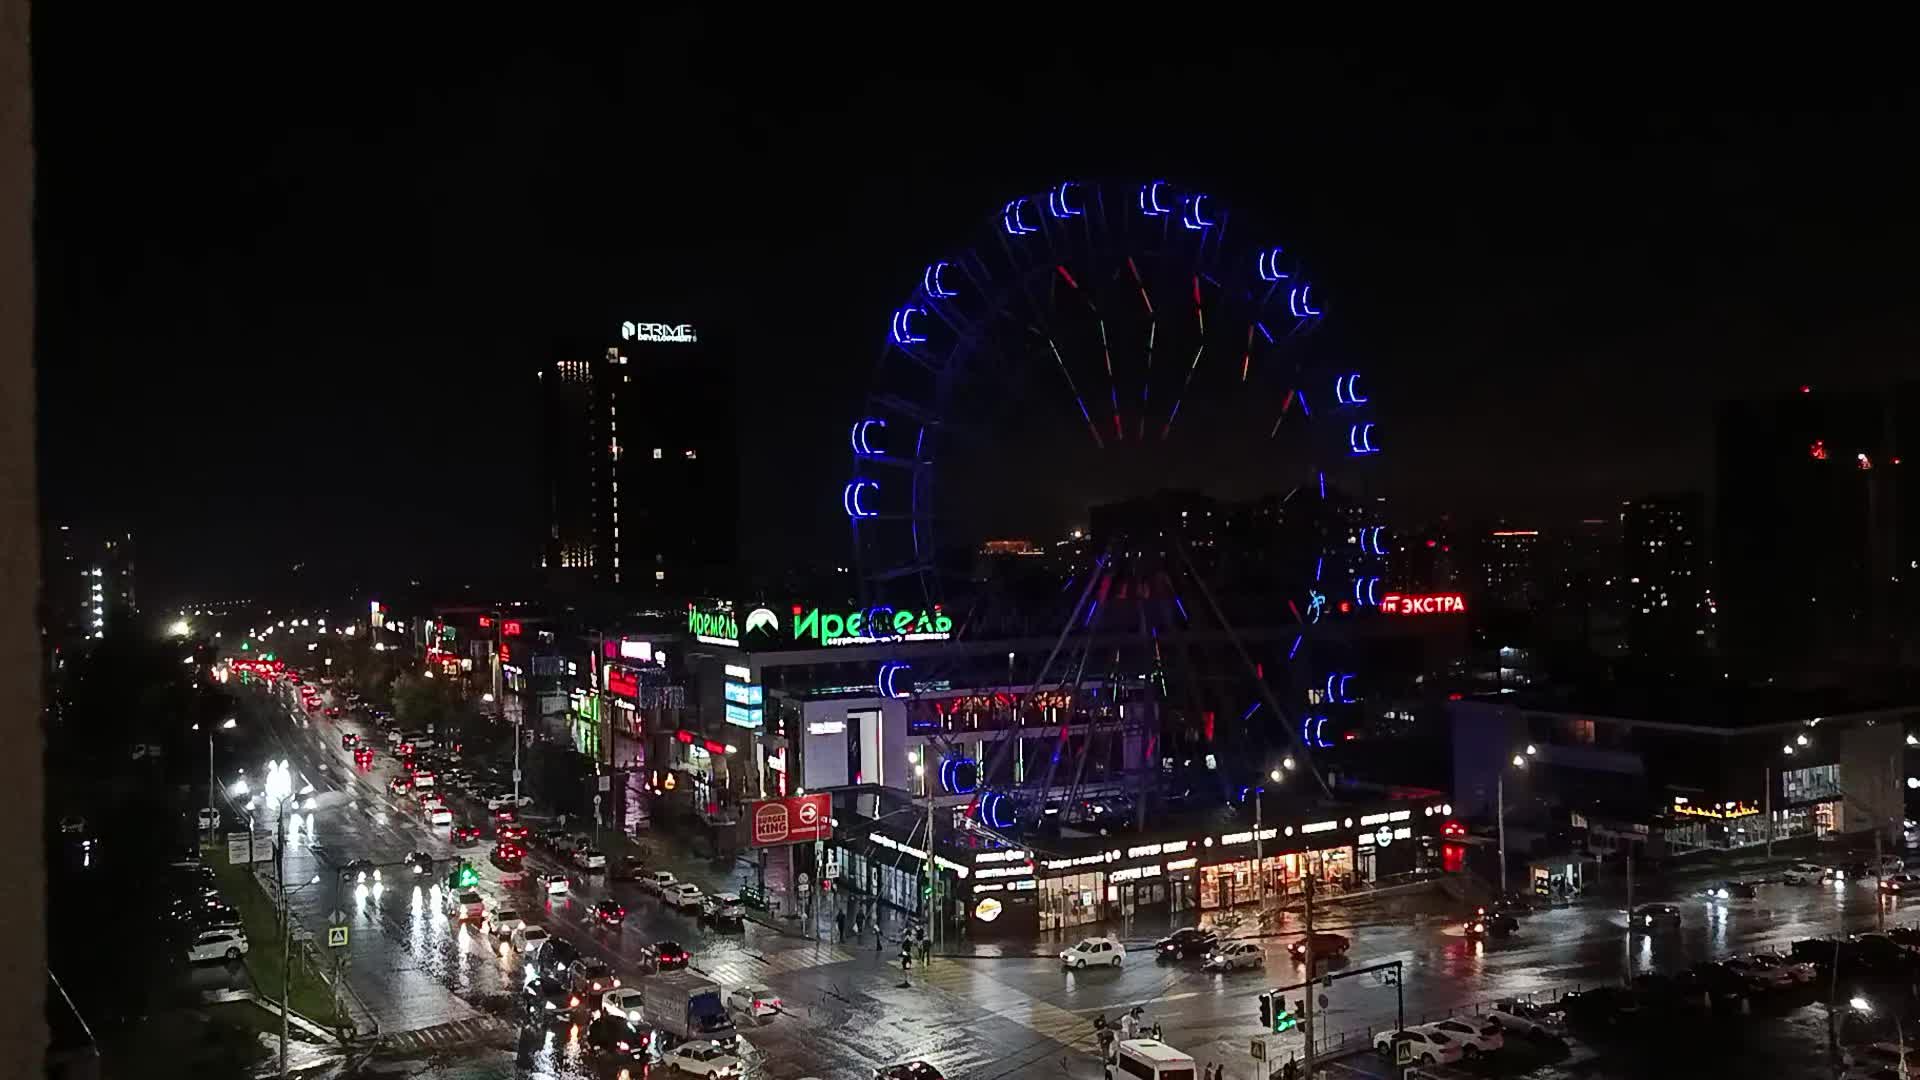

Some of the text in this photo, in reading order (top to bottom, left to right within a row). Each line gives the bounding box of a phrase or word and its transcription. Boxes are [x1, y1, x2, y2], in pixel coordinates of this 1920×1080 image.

[1402, 596, 1465, 614] ЭКСТРА
[689, 603, 738, 639] Иремель
[792, 605, 952, 646] Иреель
[758, 814, 786, 824] BURGER
[758, 822, 786, 834] KING
